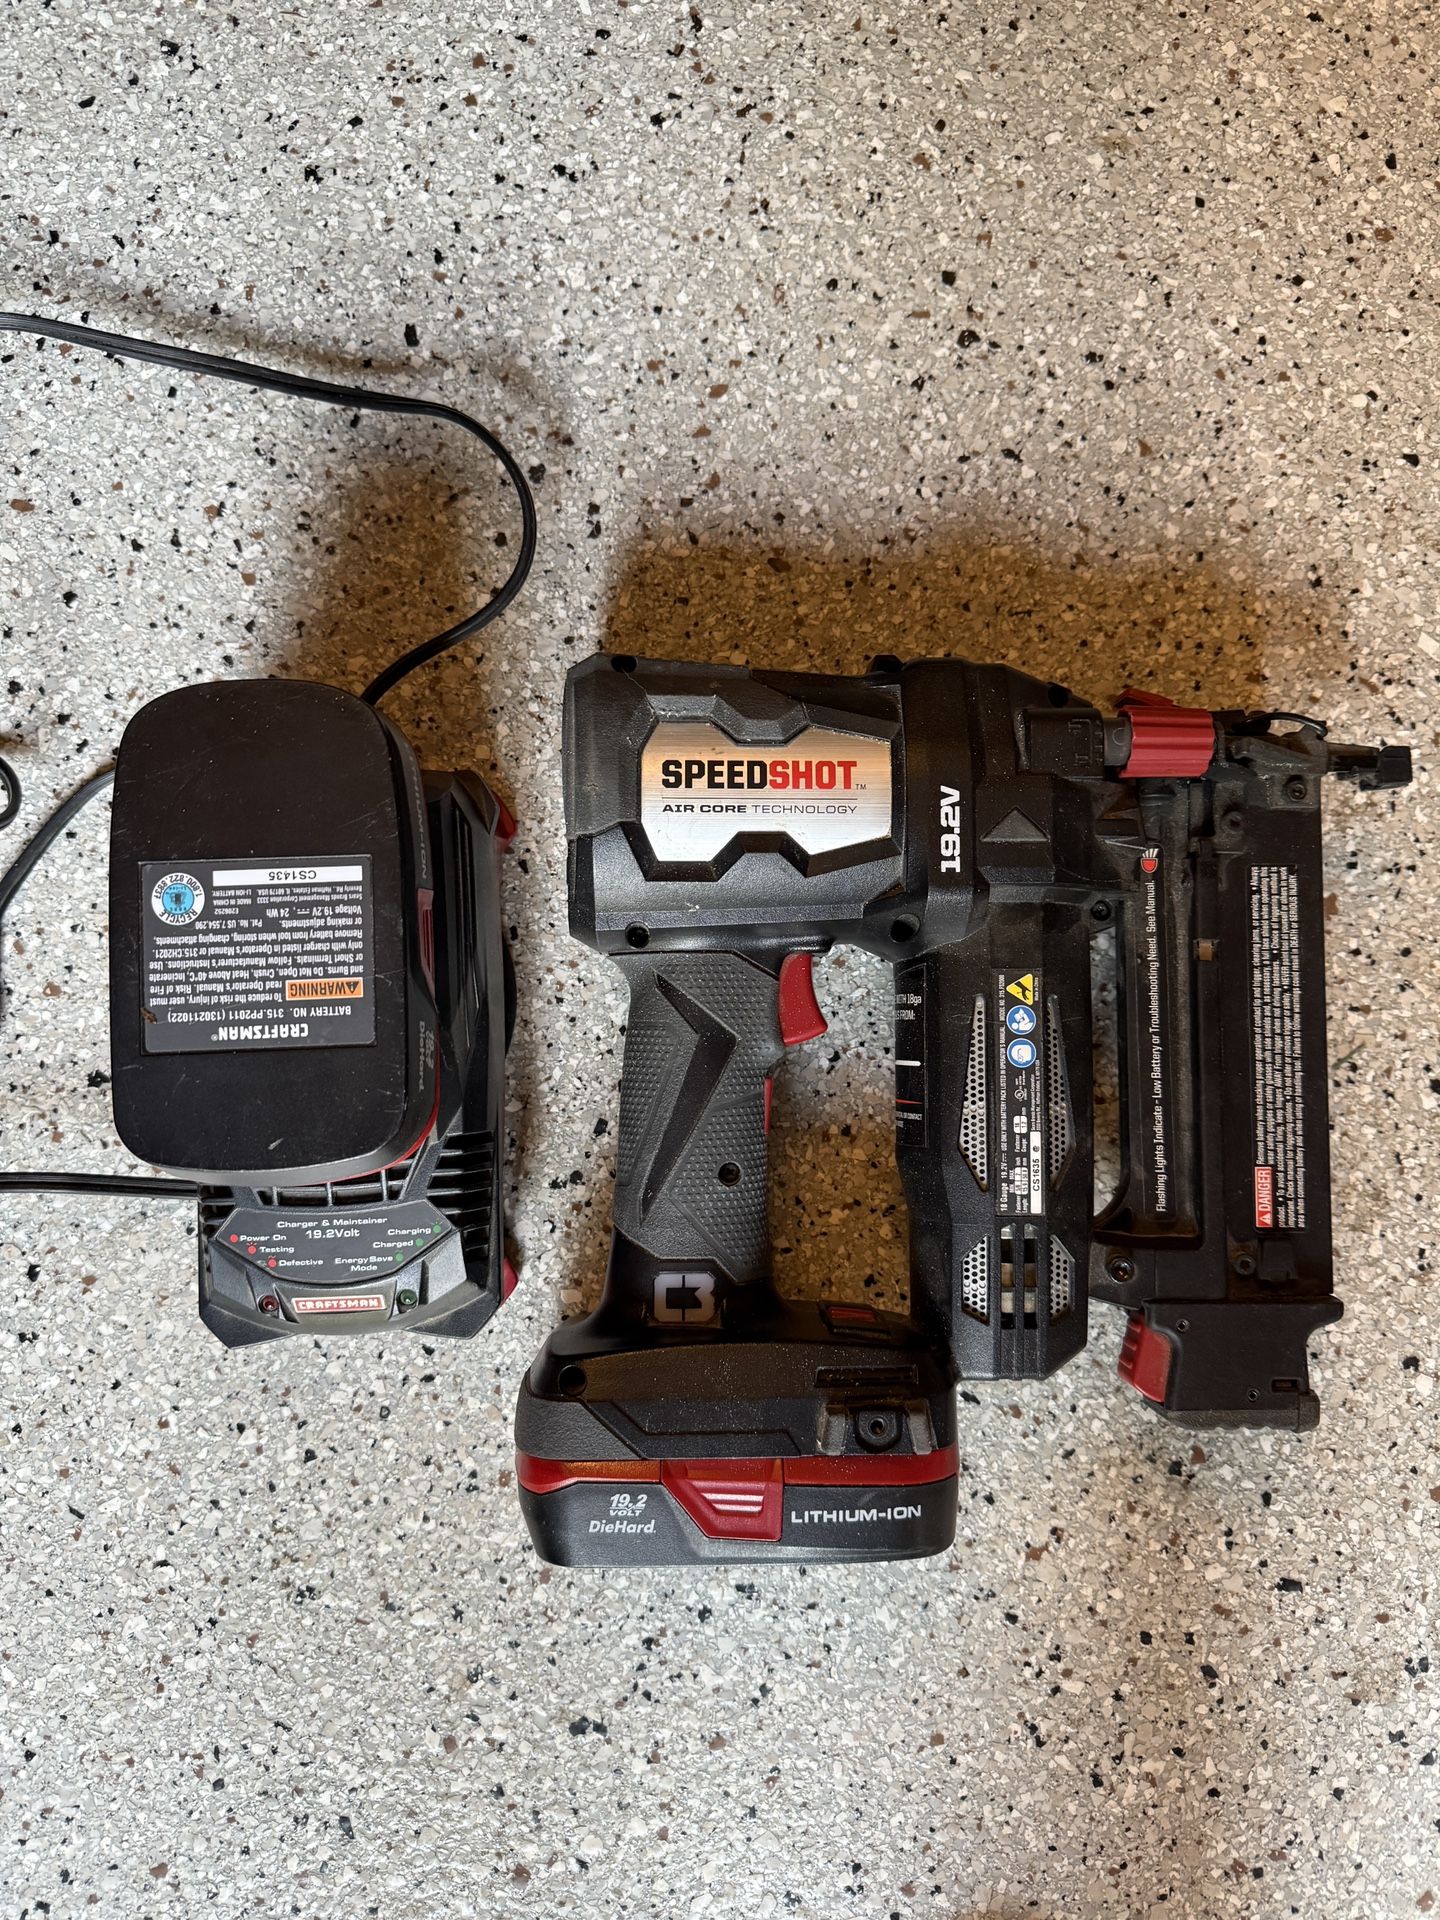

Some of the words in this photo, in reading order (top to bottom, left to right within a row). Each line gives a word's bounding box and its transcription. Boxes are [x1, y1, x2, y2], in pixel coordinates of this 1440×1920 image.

[662, 760, 858, 790] SPEEDSHOT
[662, 804, 695, 813] AIR
[700, 804, 747, 813] CORE
[751, 804, 858, 814] TECHNOLOGY
[940, 785, 961, 874] 19.2V
[267, 869, 316, 881] CS1435
[1144, 879, 1155, 914] Manual.
[265, 907, 278, 917] Wh
[279, 907, 289, 917] 24
[311, 905, 333, 916] 19.2V
[334, 903, 362, 915] Voltage
[158, 907, 197, 924] RECYCLE
[326, 915, 353, 927] making
[354, 916, 362, 925] or
[226, 919, 236, 928] US
[237, 919, 248, 928] No.
[249, 918, 262, 927] Pat.
[278, 916, 325, 929] adjustments.
[1145, 915, 1156, 932] See
[197, 932, 230, 945] changing
[230, 931, 257, 943] storing,
[257, 932, 277, 942] when
[277, 931, 291, 941] tool
[291, 930, 308, 941] from
[309, 927, 333, 940] battery
[333, 928, 362, 939] Remove
[153, 933, 197, 946] attachments,
[347, 938, 363, 950] only
[198, 946, 207, 955] or
[207, 945, 234, 956] Manual
[235, 942, 272, 955] Operator's
[272, 943, 280, 953] in
[281, 942, 301, 953] listed
[302, 940, 330, 952] charger
[331, 941, 346, 951] with
[1146, 935, 1157, 960] Need.
[151, 947, 198, 959] 315.CH2021.
[293, 953, 332, 964] Terminals.
[333, 952, 354, 963] Short
[355, 952, 363, 961] or
[148, 960, 163, 970] Use
[164, 958, 210, 970] Instructions.
[210, 956, 266, 968] Manufacturer's
[267, 955, 292, 966] Follow
[231, 969, 249, 979] Heat
[250, 967, 274, 978] Crush,
[275, 966, 297, 977] Open,
[298, 966, 311, 976] Not
[312, 966, 323, 976] Do
[324, 965, 348, 975] Burns.
[349, 964, 363, 974] and
[148, 971, 185, 983] Incinerate
[208, 970, 231, 980] Above
[148, 984, 164, 995] Fire
[165, 984, 173, 994] of
[175, 983, 191, 994] Risk
[192, 982, 224, 993] Manual.
[225, 979, 263, 992] Operator's
[265, 980, 282, 990] read
[289, 981, 345, 996] WARNING
[149, 997, 168, 1007] must
[169, 996, 185, 1004] user
[185, 993, 210, 1005] injury,
[210, 995, 218, 1004] of
[219, 994, 233, 1004] risk
[234, 993, 246, 1004] the
[247, 992, 272, 1003] reduce
[273, 992, 282, 1002] To
[1147, 961, 1161, 1032] Troubleshooting
[167, 1008, 225, 1022] (130211022)
[228, 1008, 284, 1020] 315.PP2011
[289, 1007, 306, 1017] NO.
[309, 1005, 351, 1016] BATTERY
[1151, 1034, 1160, 1043] or
[1150, 1044, 1162, 1078] Battery
[1151, 1079, 1162, 1097] Low
[1152, 1105, 1163, 1143] Indicate
[1153, 1144, 1166, 1172] Lights
[1000, 1182, 1008, 1202] Gauge
[1154, 1173, 1167, 1211] Flashing
[1257, 1169, 1270, 1211] DANGER
[1001, 1203, 1007, 1211] 18
[276, 1219, 318, 1229] Charger
[332, 1216, 388, 1226] Maintainer
[304, 1227, 360, 1240] 19.2Volt
[386, 1226, 431, 1236] Charging
[239, 1233, 270, 1242] Power
[272, 1233, 286, 1241] On
[259, 1245, 295, 1254] Testing
[372, 1239, 414, 1249] Charged
[278, 1257, 324, 1267] Defective
[334, 1255, 369, 1265] Energy
[369, 1254, 393, 1262] Save
[350, 1264, 377, 1272] Mode
[297, 1297, 379, 1310] CRAFTSMAN
[610, 1494, 648, 1509] 19.2
[791, 1505, 922, 1523] LITHIUM-ION
